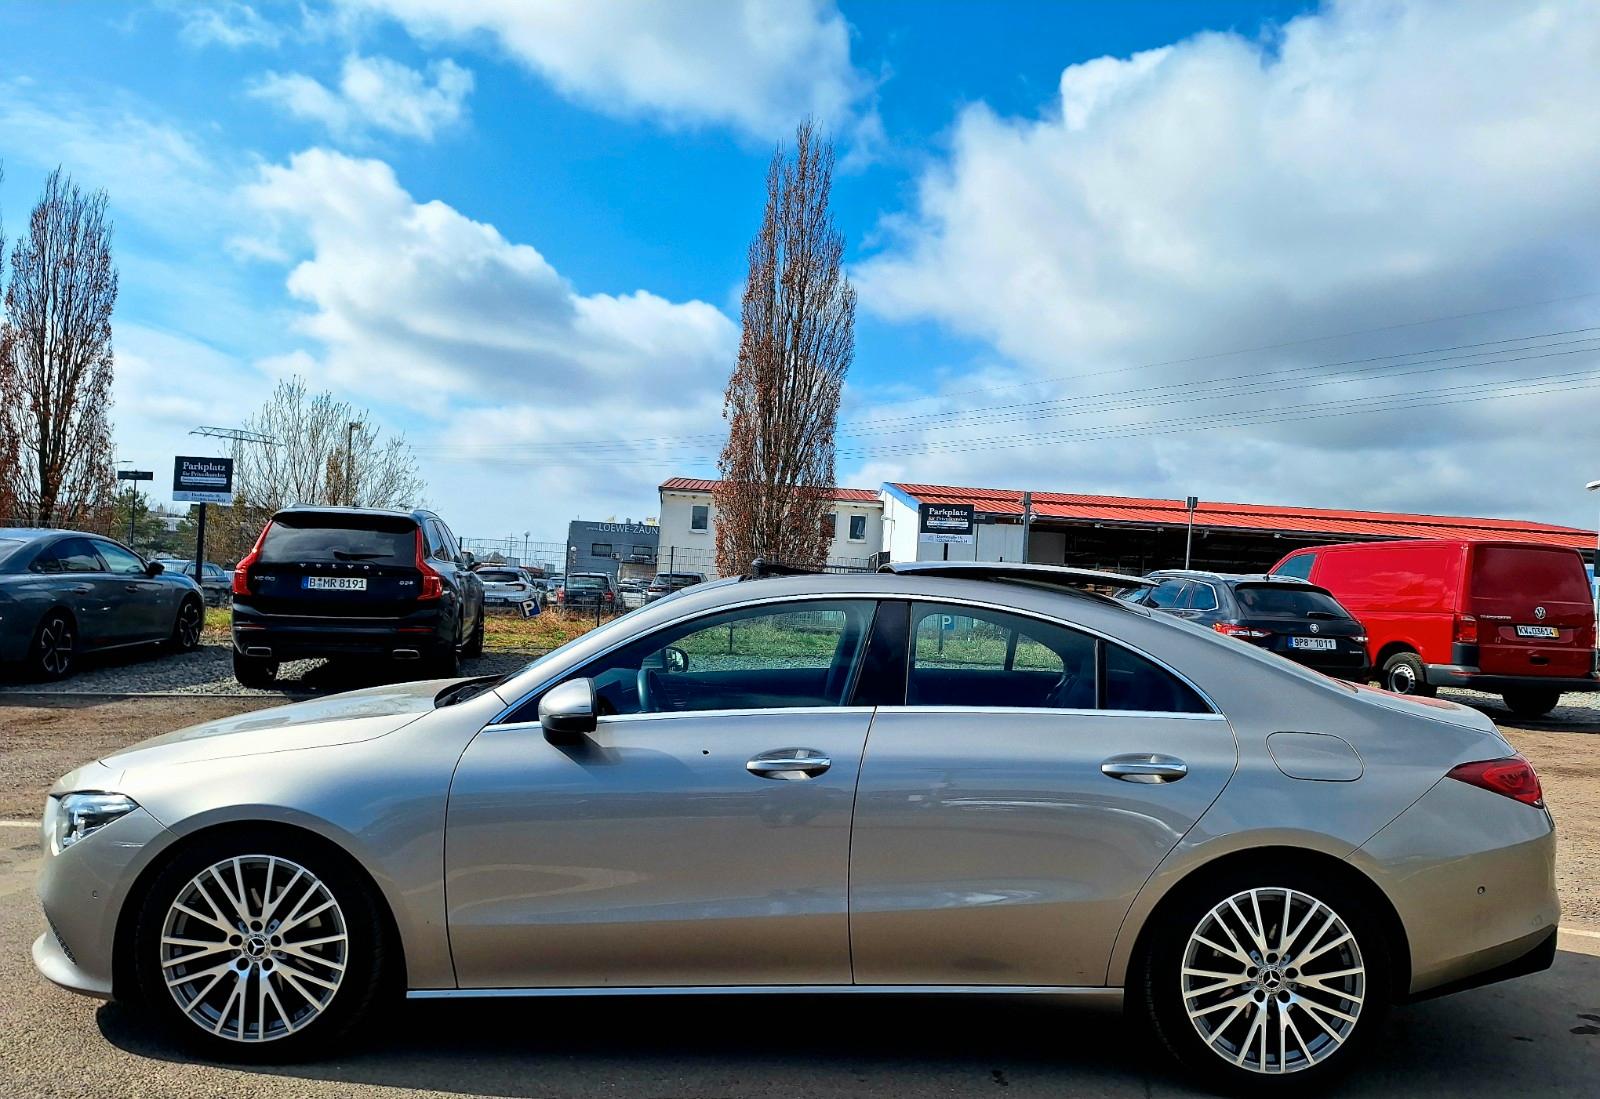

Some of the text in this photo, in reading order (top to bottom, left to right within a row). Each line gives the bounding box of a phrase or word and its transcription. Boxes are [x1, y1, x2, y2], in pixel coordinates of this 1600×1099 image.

[183, 461, 226, 472] Parkplatz
[928, 507, 968, 517] Parkplatz
[599, 523, 658, 535] LOEWE-ZAUN
[522, 600, 535, 617] P
[941, 615, 952, 630] P
